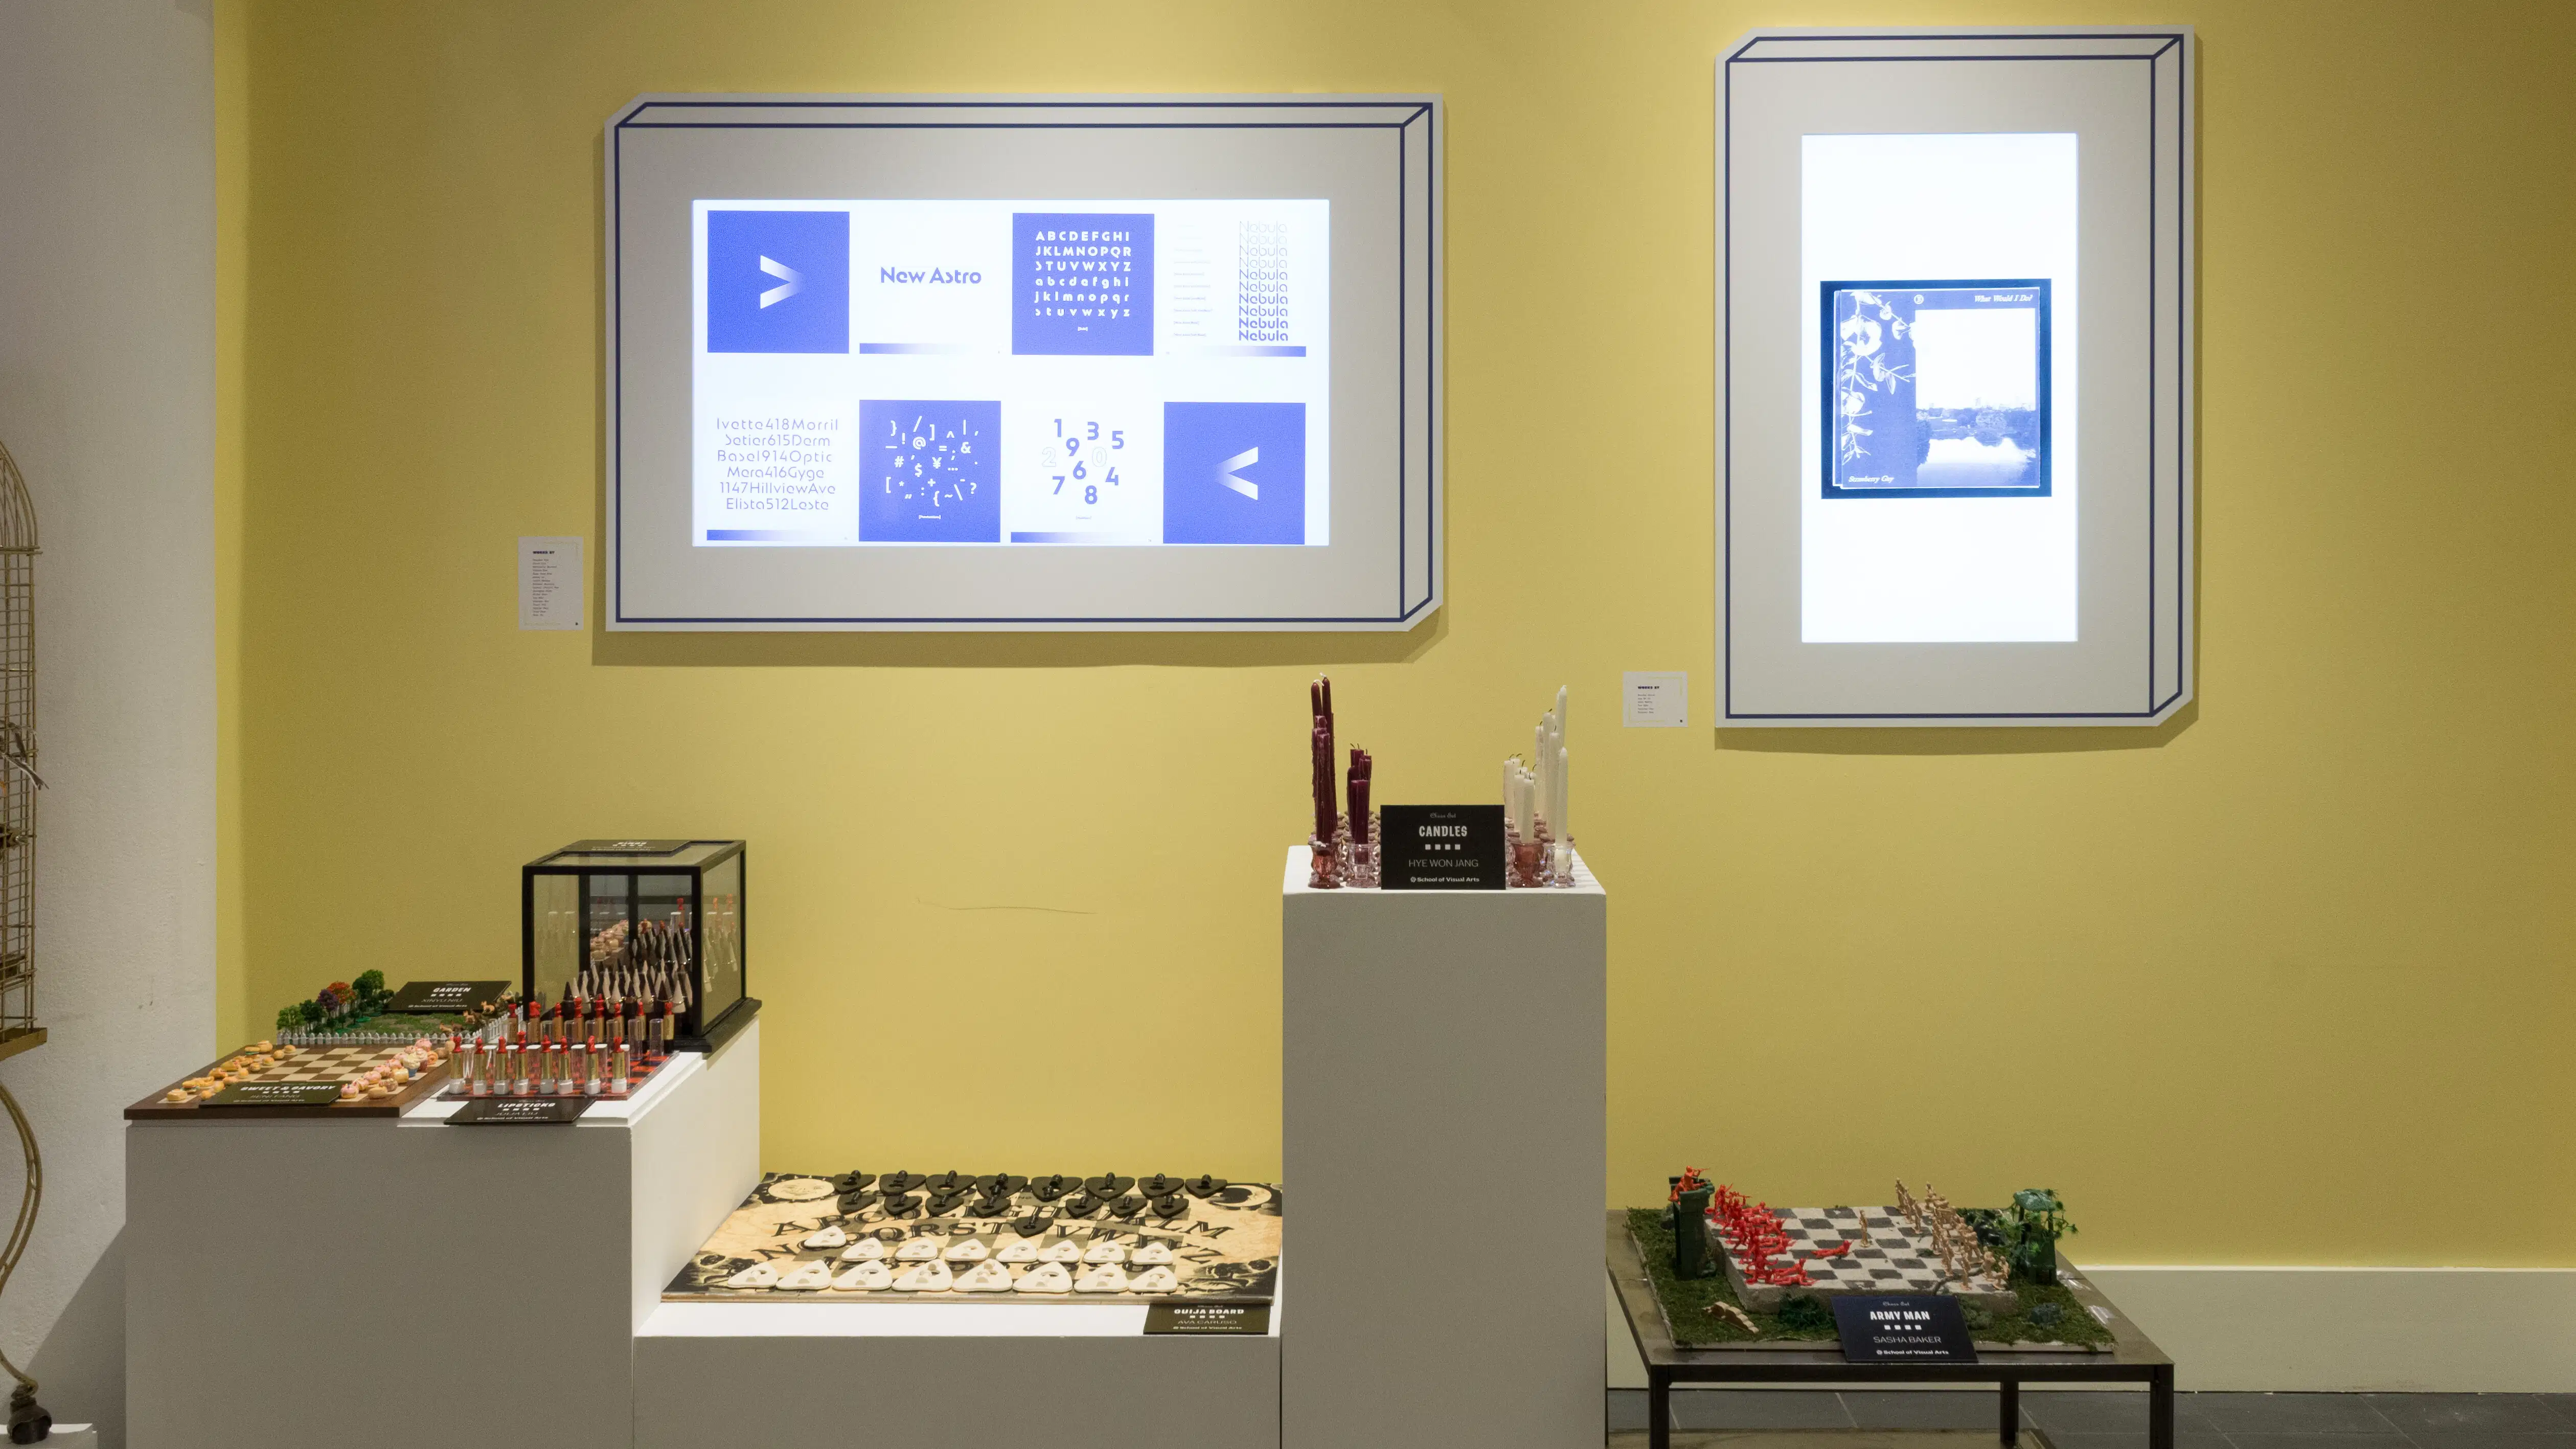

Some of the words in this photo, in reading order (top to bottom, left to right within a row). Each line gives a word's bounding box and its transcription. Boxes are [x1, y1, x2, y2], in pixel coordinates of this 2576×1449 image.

[1240, 221, 1287, 233] Nebula
[1240, 234, 1287, 245] Nebula
[1240, 245, 1287, 256] Nebula
[1240, 258, 1287, 268] Nebula
[881, 267, 925, 283] New
[929, 267, 981, 284] Astro
[1240, 269, 1287, 280] Nebula
[1240, 281, 1287, 292] Nebula
[1240, 293, 1287, 304] Nebula
[1240, 306, 1287, 316] Nebula
[1240, 318, 1287, 328] Nebula
[1240, 330, 1287, 341] Nebula
[1054, 419, 1061, 437] 1
[1087, 422, 1099, 440] 3
[1112, 431, 1124, 449] 5
[1066, 438, 1079, 456] 9
[1073, 461, 1086, 480] 6
[1105, 467, 1119, 485] 4
[1053, 476, 1065, 494] 7
[1085, 485, 1097, 504] 8
[1419, 826, 1467, 836] CANDLES
[1870, 1311, 1901, 1320] ARMY
[1903, 1311, 1930, 1320] MAN
